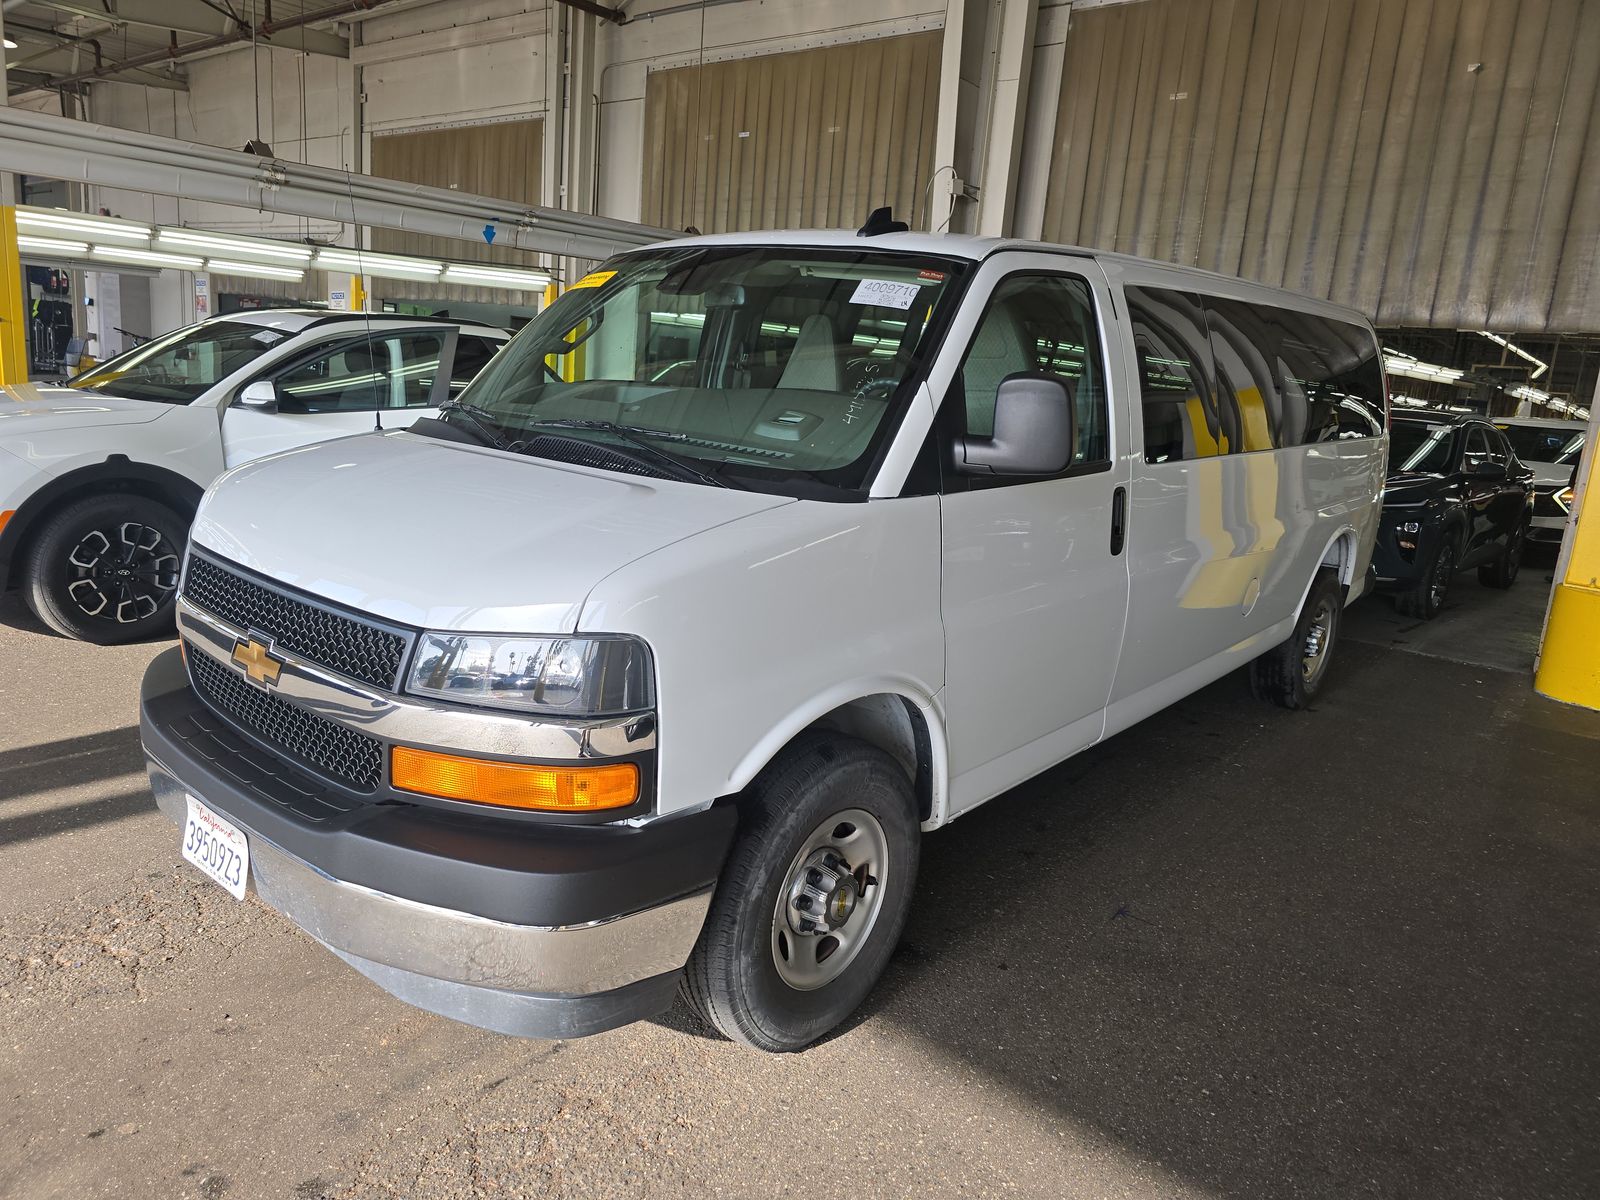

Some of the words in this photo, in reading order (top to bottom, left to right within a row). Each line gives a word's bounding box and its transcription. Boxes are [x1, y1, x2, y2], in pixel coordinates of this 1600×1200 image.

[864, 282, 919, 298] 4009710
[199, 807, 235, 844] California
[187, 820, 242, 887] 39509Z3
